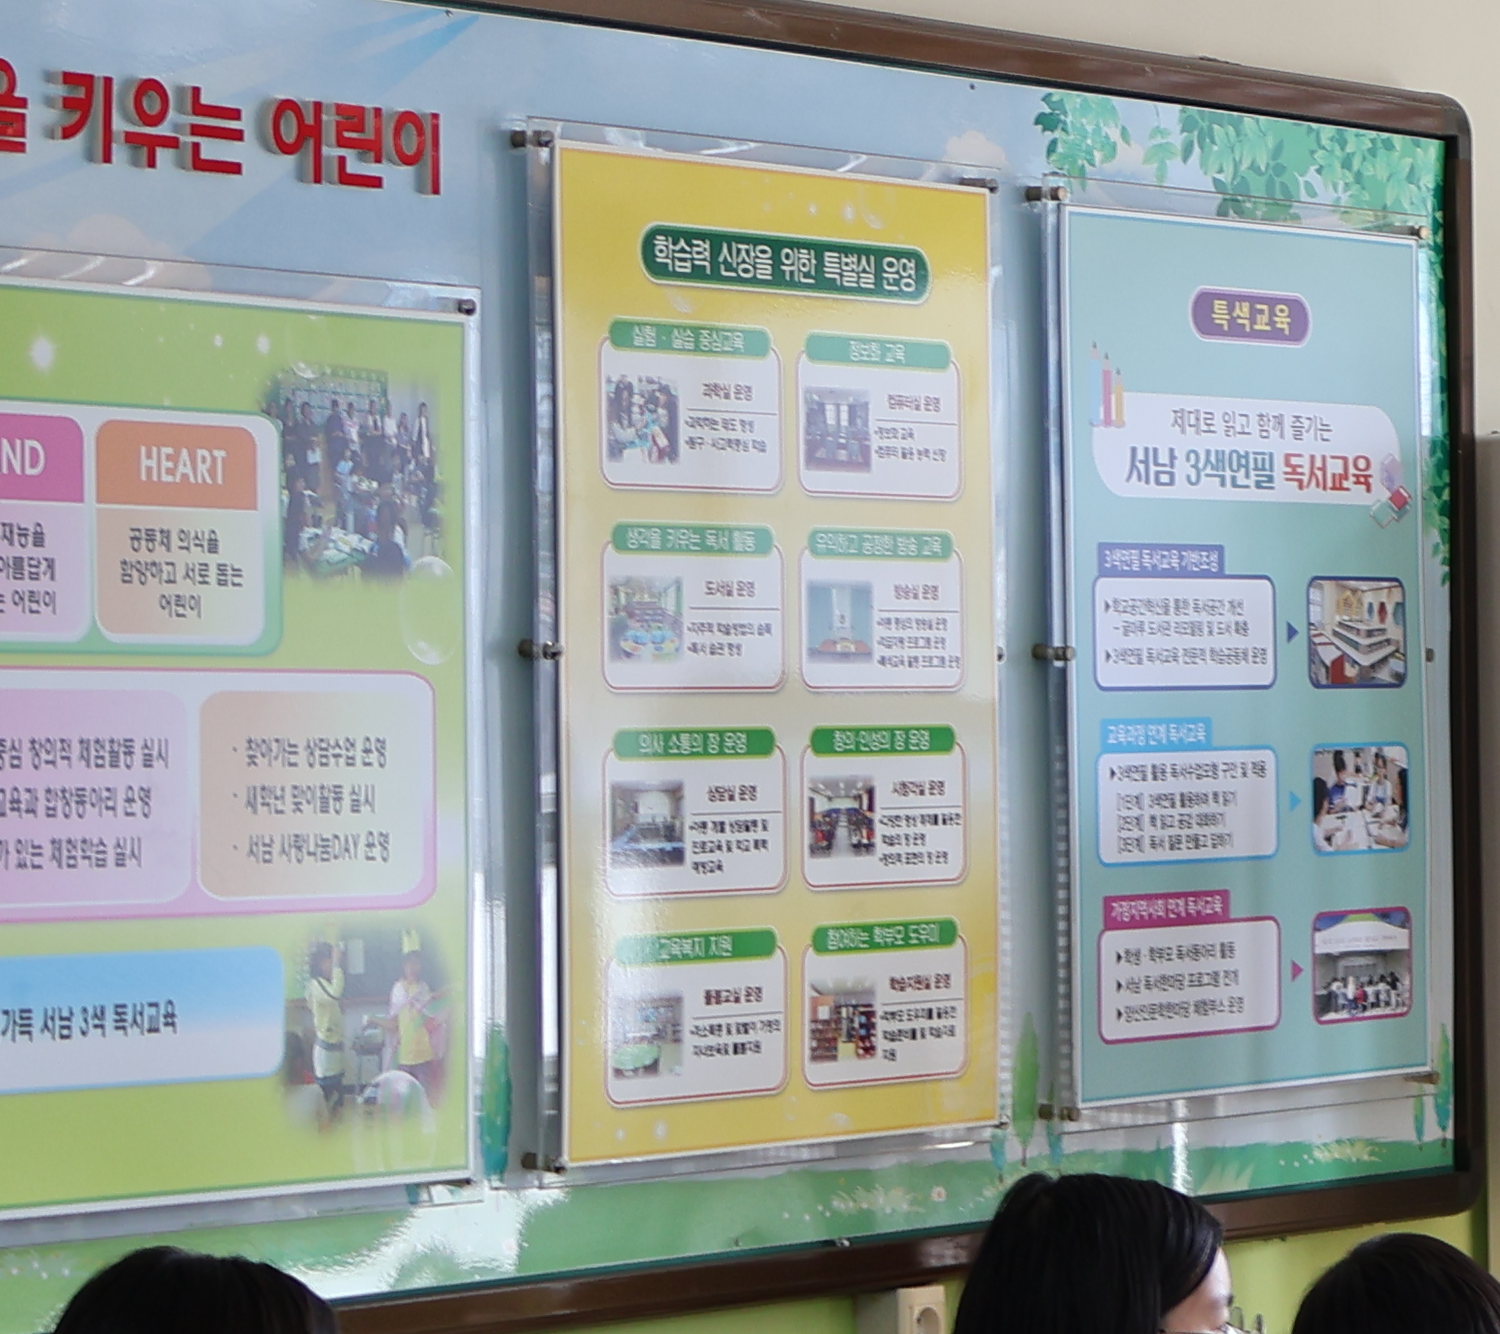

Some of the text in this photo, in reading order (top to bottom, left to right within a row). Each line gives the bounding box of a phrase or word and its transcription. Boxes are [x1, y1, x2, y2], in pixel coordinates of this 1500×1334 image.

[55, 70, 243, 175] 키우는
[262, 98, 442, 196] 어린이
[653, 235, 916, 293] 학습력 신장을 위한 특별실 운영
[1211, 299, 1291, 335] 특색교육
[1171, 409, 1333, 442] 제대로 읽고 함께 즐기는
[139, 445, 228, 485] HEART
[1126, 446, 1373, 493] 서남 3색연필 독서교육
[0, 521, 46, 549] 재능을
[129, 527, 220, 555] 공동체 의식을
[119, 559, 243, 589] 함양하고 서로 돕는
[11, 588, 57, 616] 어린이
[158, 593, 202, 620] 어린이
[28, 736, 73, 771] 창의적
[78, 736, 136, 771] 체험활동
[141, 736, 170, 770] 실시
[245, 735, 387, 769] 찾아가는 상담수업 운영
[723, 732, 747, 753] 운영
[44, 785, 118, 819] 합창동아리
[123, 784, 152, 819] 운영
[245, 783, 375, 816] 새학년 맞이활동 실시
[15, 837, 44, 870] 있는
[50, 835, 108, 869] 체험학습
[113, 835, 142, 869] 실시
[247, 833, 275, 864] 서남
[364, 829, 390, 864] 운영
[40, 1005, 75, 1041] 서남
[112, 999, 179, 1037] 독서교육
